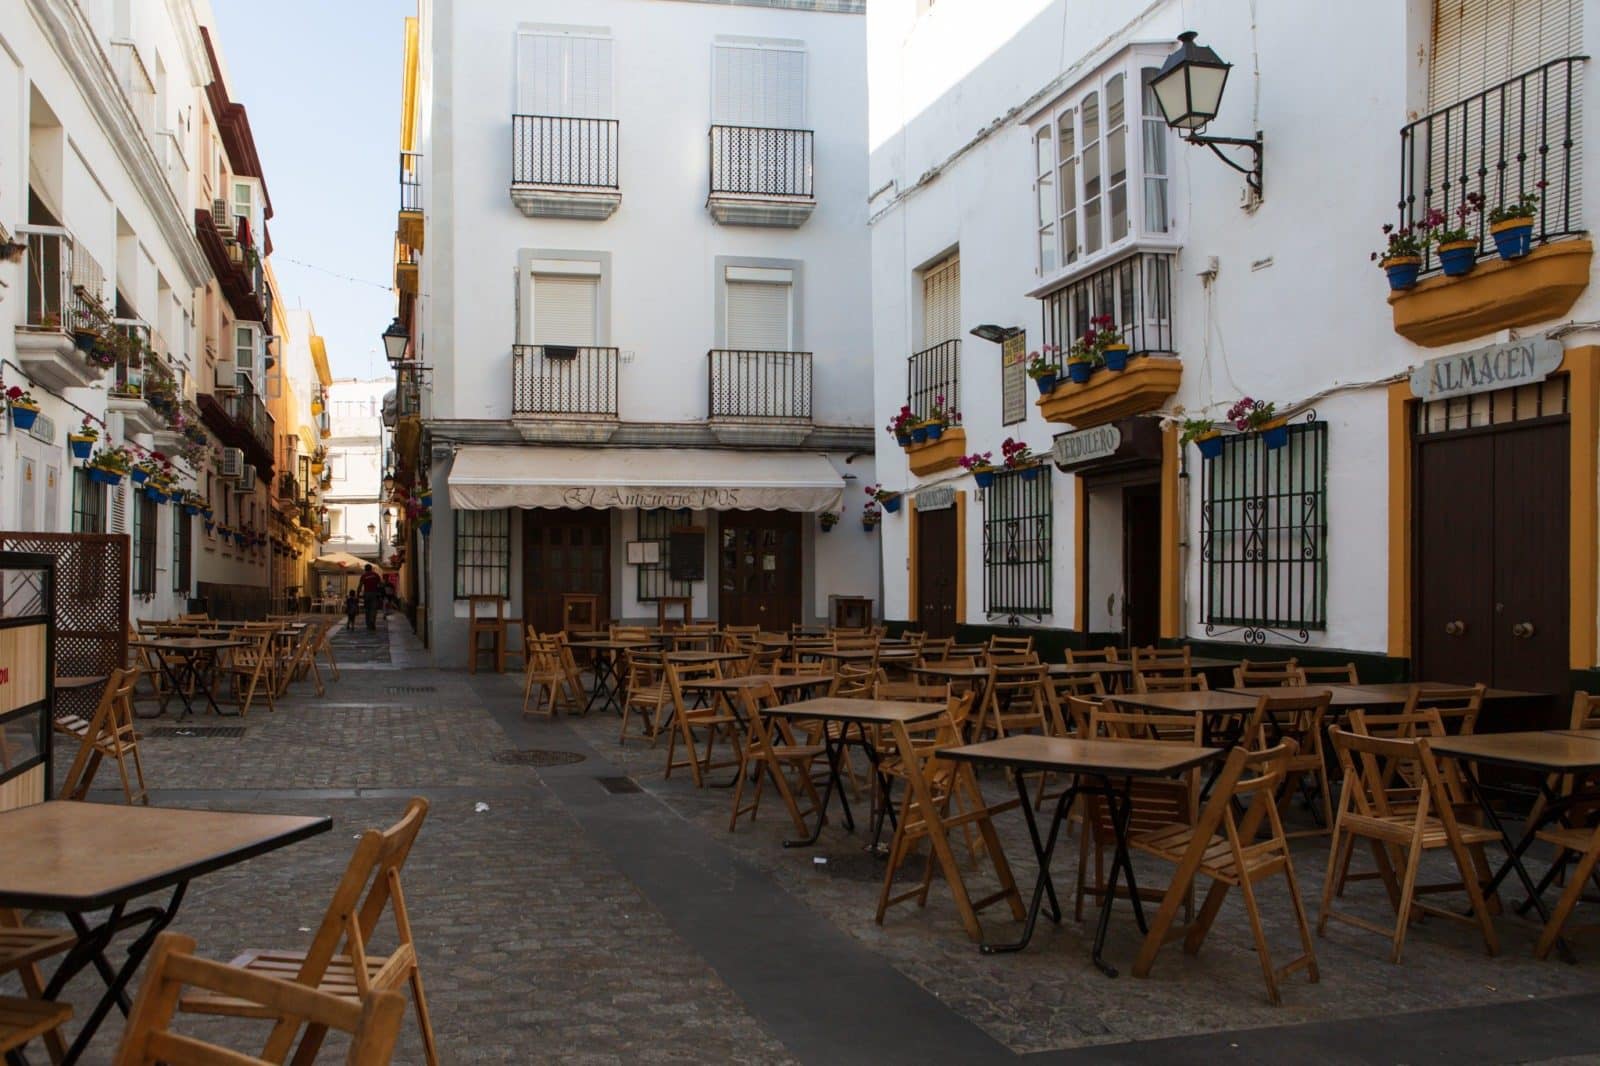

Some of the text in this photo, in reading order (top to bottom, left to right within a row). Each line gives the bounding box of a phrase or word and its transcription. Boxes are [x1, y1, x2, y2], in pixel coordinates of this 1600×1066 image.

[1057, 427, 1115, 459] VERDULERO
[563, 486, 741, 506] El Anticuario 1905
